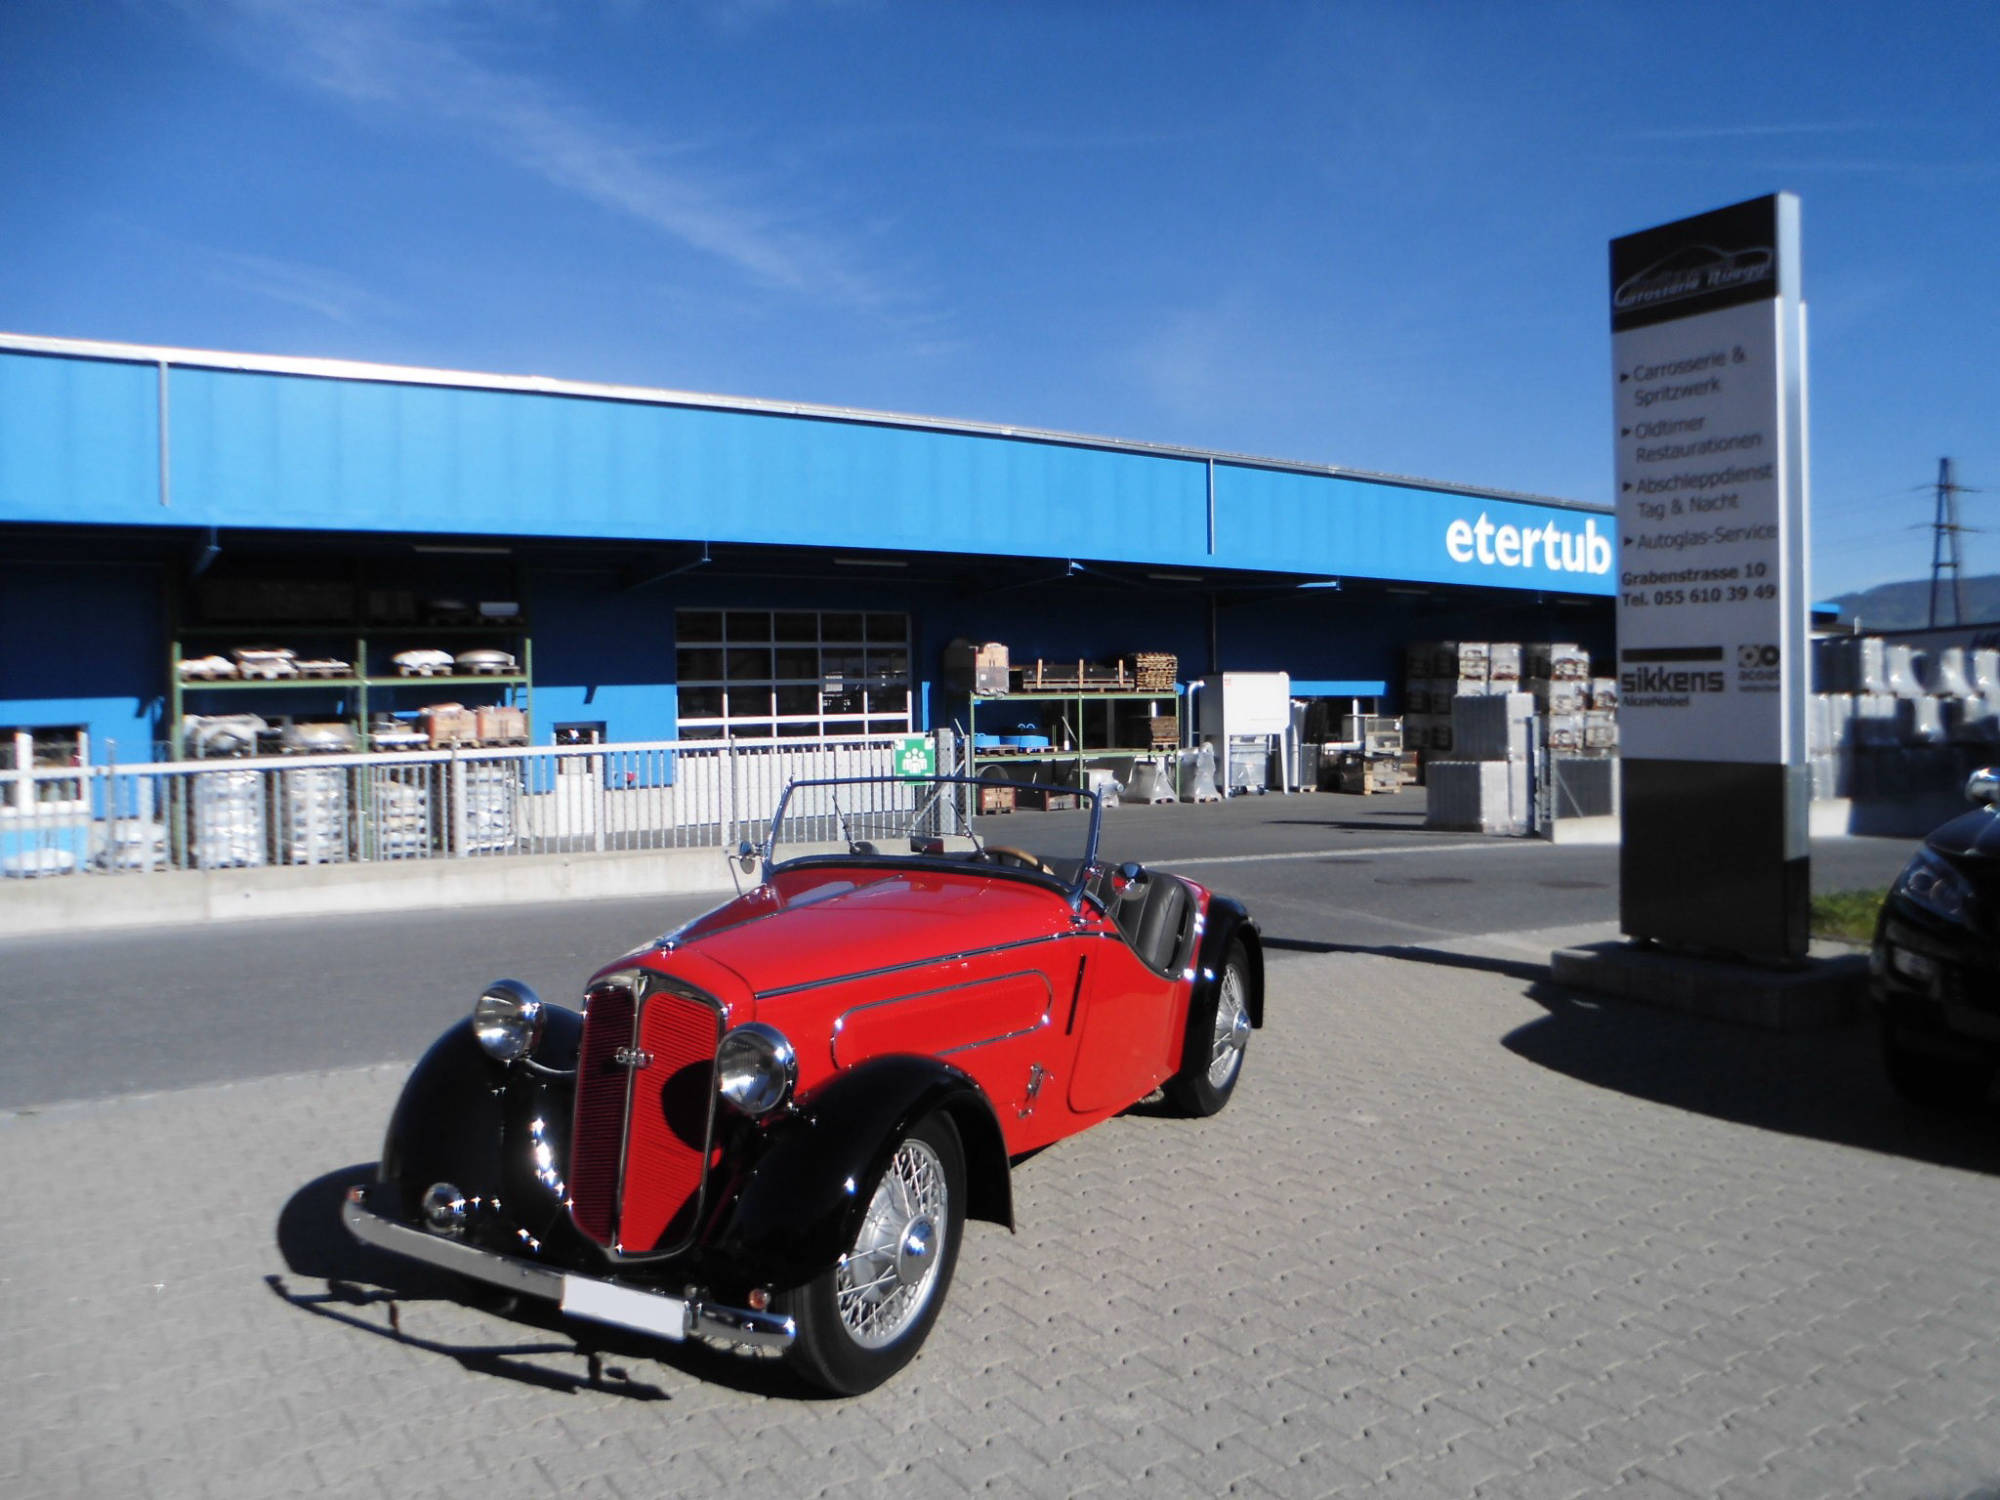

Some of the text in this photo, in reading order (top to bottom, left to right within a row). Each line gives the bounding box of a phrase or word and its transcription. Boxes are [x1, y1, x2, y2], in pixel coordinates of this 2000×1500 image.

[1633, 346, 1747, 382] Carrosserie &
[1635, 377, 1721, 407] Spritzwerk
[1636, 417, 1705, 439] Oldtimer
[1637, 433, 1762, 463] Restaurationen
[1637, 464, 1773, 494] Abschleppdienst
[1638, 494, 1739, 520] Tag & Nacht
[1446, 511, 1612, 575] etertub
[1637, 523, 1778, 550] Autoglas-Service
[1622, 562, 1767, 586] Grabenstrasse 10
[1623, 584, 1776, 607] Tel. 055 610 39 49
[1621, 666, 1725, 693] sikkens
